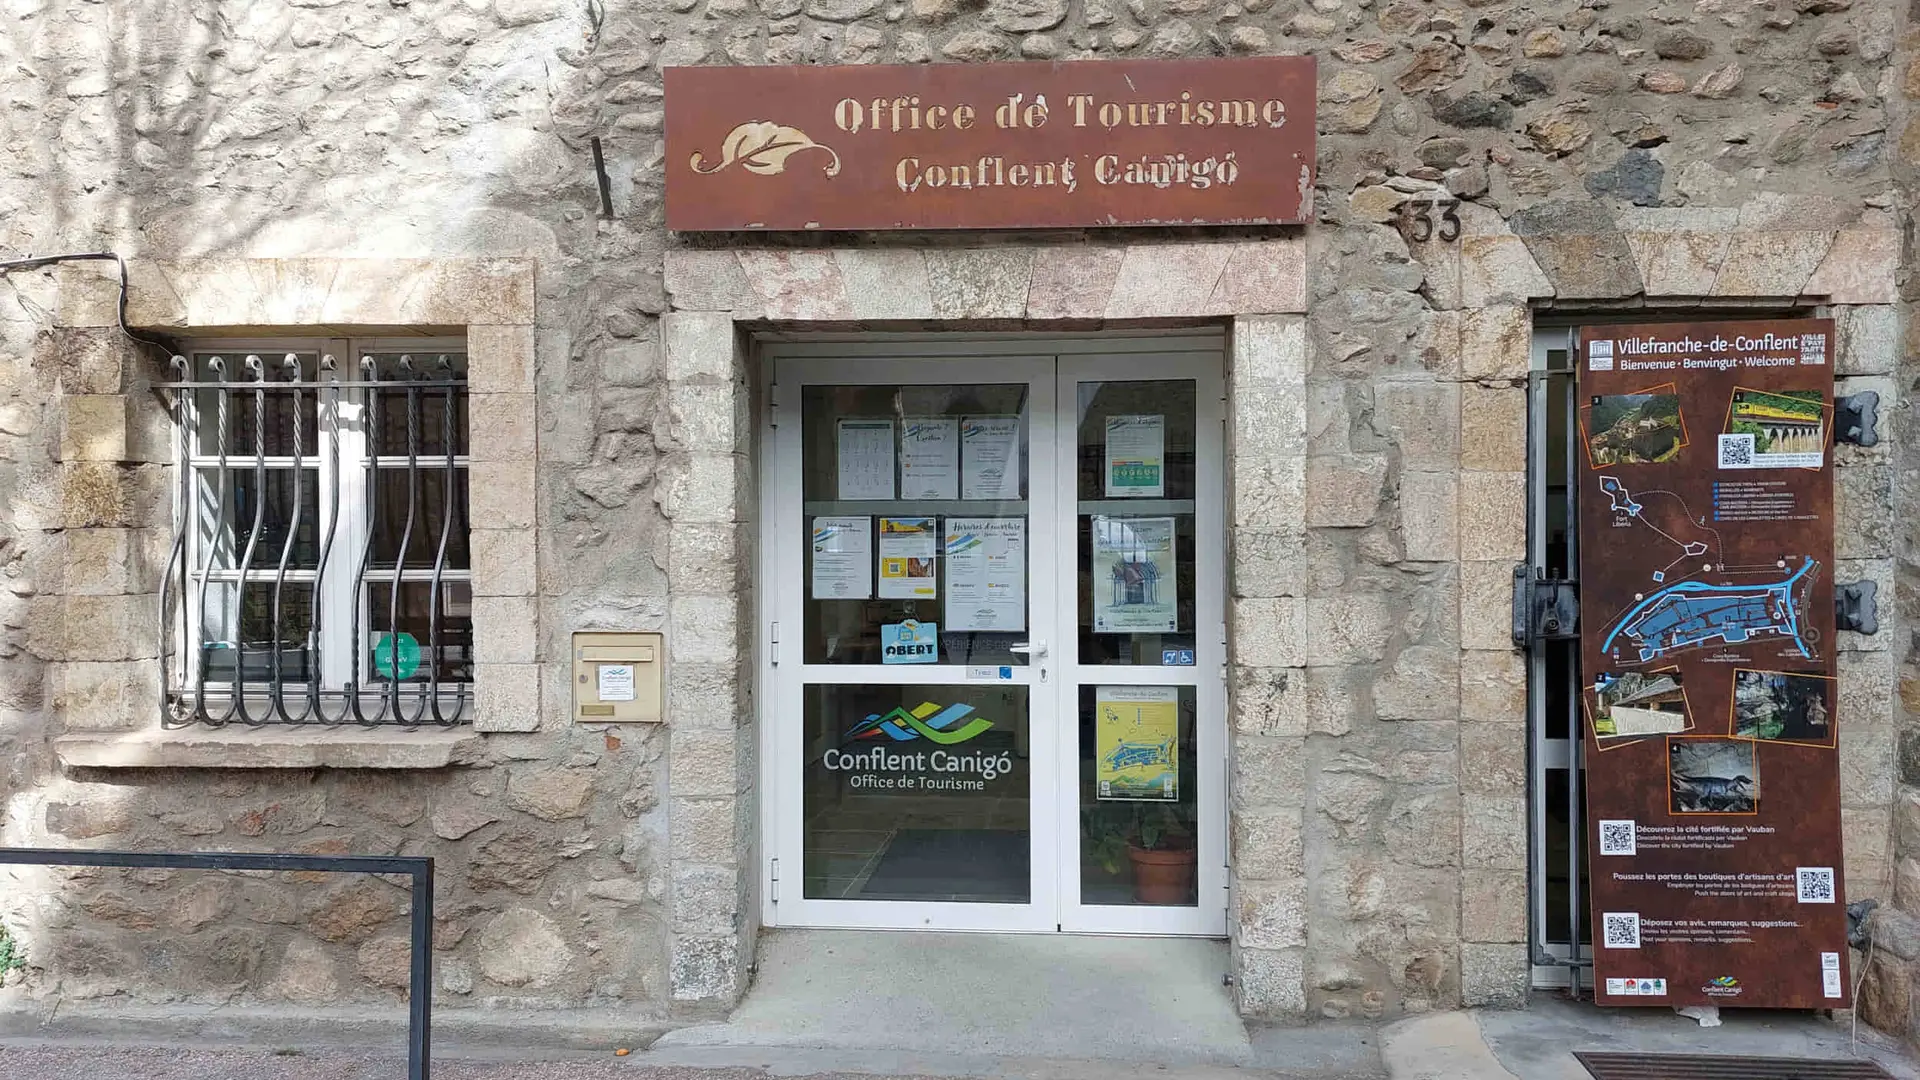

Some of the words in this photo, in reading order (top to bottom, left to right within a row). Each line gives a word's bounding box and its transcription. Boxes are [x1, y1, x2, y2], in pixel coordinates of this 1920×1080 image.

[834, 94, 976, 132] Office
[1067, 91, 1287, 130] Tourisme
[895, 156, 1077, 192] Conflent
[1094, 151, 1239, 189] Canigó
[1411, 200, 1460, 242] 33
[1618, 333, 1799, 355] Villefranche-de-Conflent
[1620, 358, 1676, 371] Bienvenue
[1683, 357, 1737, 371] Benvingut
[1743, 356, 1796, 368] Welcome
[885, 644, 934, 657] OBERT
[824, 747, 926, 771] Conflent
[930, 750, 1012, 779] Canigó
[851, 775, 894, 788] Office
[897, 775, 915, 788] de
[919, 776, 984, 790] Tourisme
[1636, 825, 1676, 833] Découvrez
[1676, 825, 1684, 833] la
[1685, 825, 1699, 833] cité
[1700, 825, 1730, 833] fortifiée
[1731, 826, 1745, 834] par
[1746, 825, 1775, 833] Vauban
[1613, 873, 1643, 881] Poussez
[1645, 873, 1656, 881] les
[1657, 873, 1682, 881] portes
[1684, 873, 1697, 881] des
[1699, 873, 1736, 881] boutiques
[1737, 873, 1775, 881] d'artisans
[1776, 873, 1795, 881] d'art
[1640, 919, 1673, 927] Déposez
[1674, 919, 1688, 927] vos
[1689, 919, 1706, 927] avis,
[1707, 919, 1750, 927] remarques,
